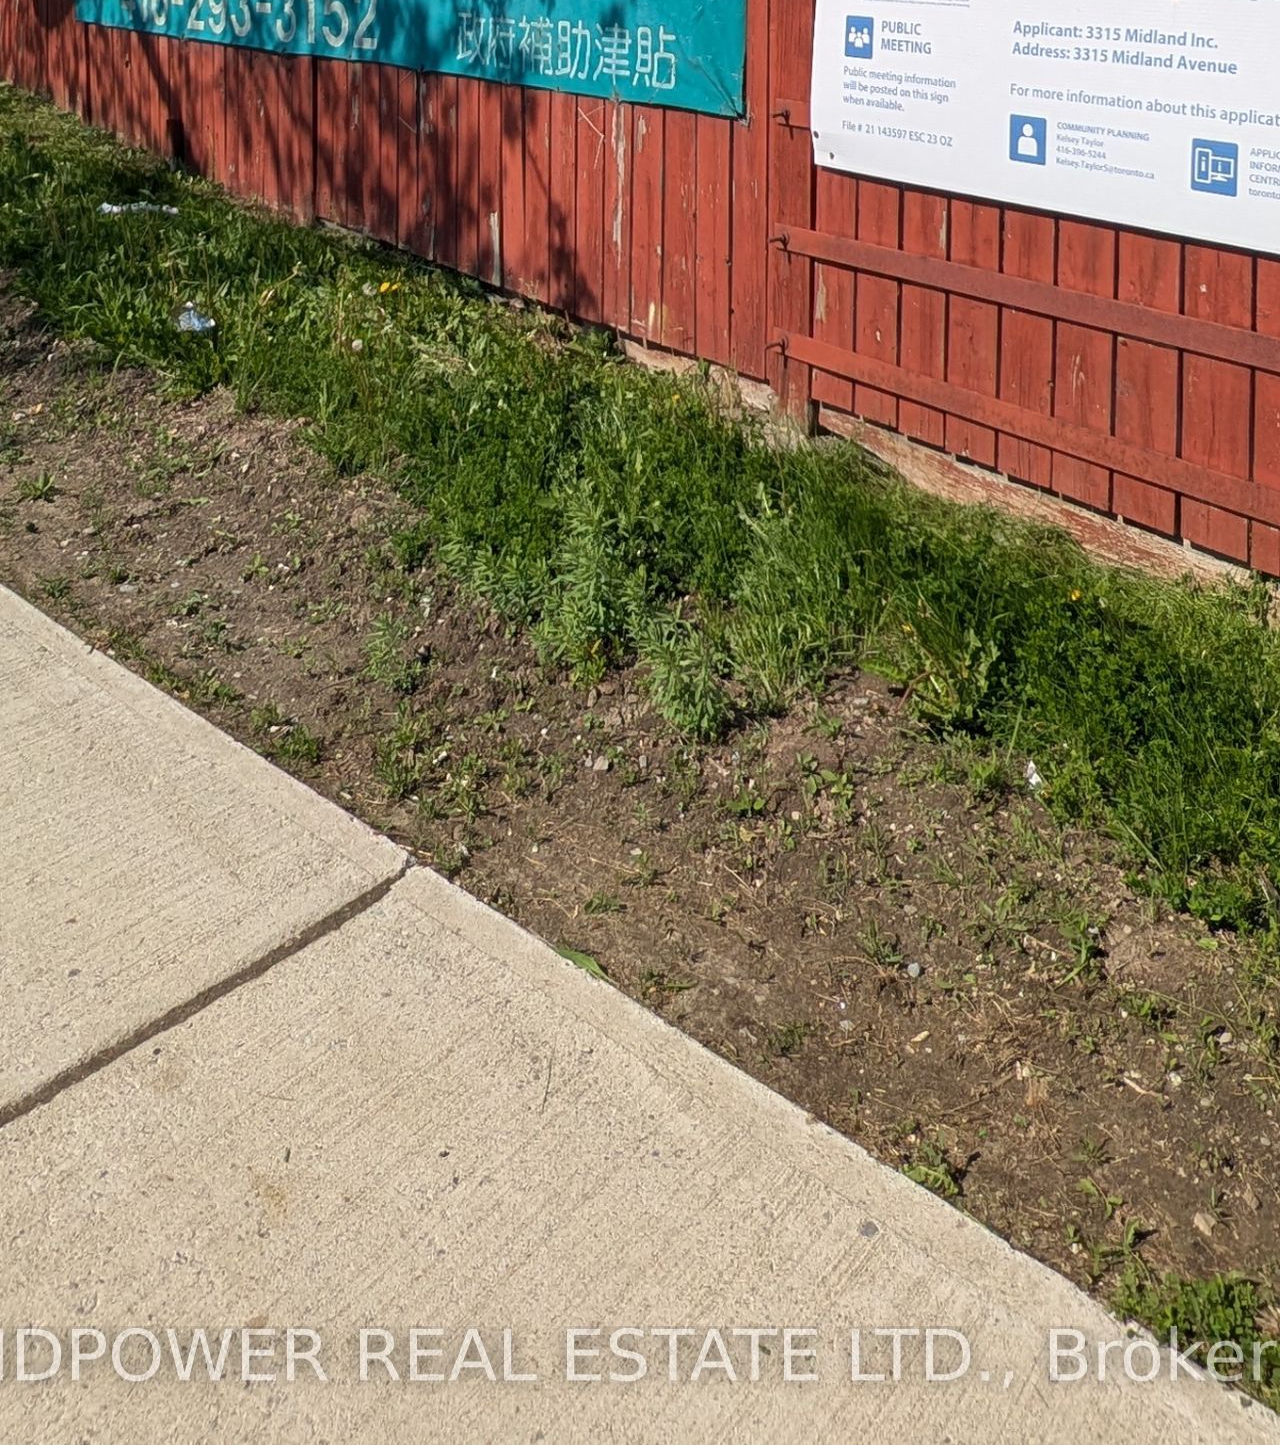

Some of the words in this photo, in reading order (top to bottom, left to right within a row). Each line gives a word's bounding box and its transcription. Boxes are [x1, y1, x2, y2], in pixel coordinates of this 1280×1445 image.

[881, 20, 922, 36] PUBLIC
[1013, 20, 1083, 39] Applicant:
[1086, 26, 1121, 41] 3315
[1125, 28, 1187, 47] Midland
[1190, 33, 1219, 49] Inc.
[456, 11, 676, 90] 政府補助津貼
[880, 38, 932, 55] MEETING
[1012, 42, 1071, 60] Address:
[1073, 47, 1108, 63] 3315
[1111, 50, 1174, 69] Midland
[1176, 56, 1238, 74] Avenue
[843, 66, 867, 78] Public
[869, 71, 903, 84] meeting
[904, 73, 957, 89] information
[843, 80, 857, 90] will
[858, 81, 869, 92] be
[870, 85, 898, 97] posted
[899, 89, 911, 98] on
[912, 89, 928, 100] this
[930, 91, 949, 104] sign
[843, 94, 865, 105] when
[866, 98, 905, 111] available.
[1010, 83, 1030, 96] For
[1032, 87, 1064, 102] more
[1066, 88, 1143, 111] information
[1146, 99, 1187, 116] about
[1190, 103, 1217, 119] this
[842, 120, 856, 132] File
[865, 124, 875, 134] 21
[878, 126, 907, 140] 143597
[909, 131, 925, 143] ESC
[927, 134, 937, 144] 23
[1056, 122, 1106, 136] COMMUNITY
[1106, 128, 1150, 141] PLANNING
[1081, 137, 1105, 148] Taylor
